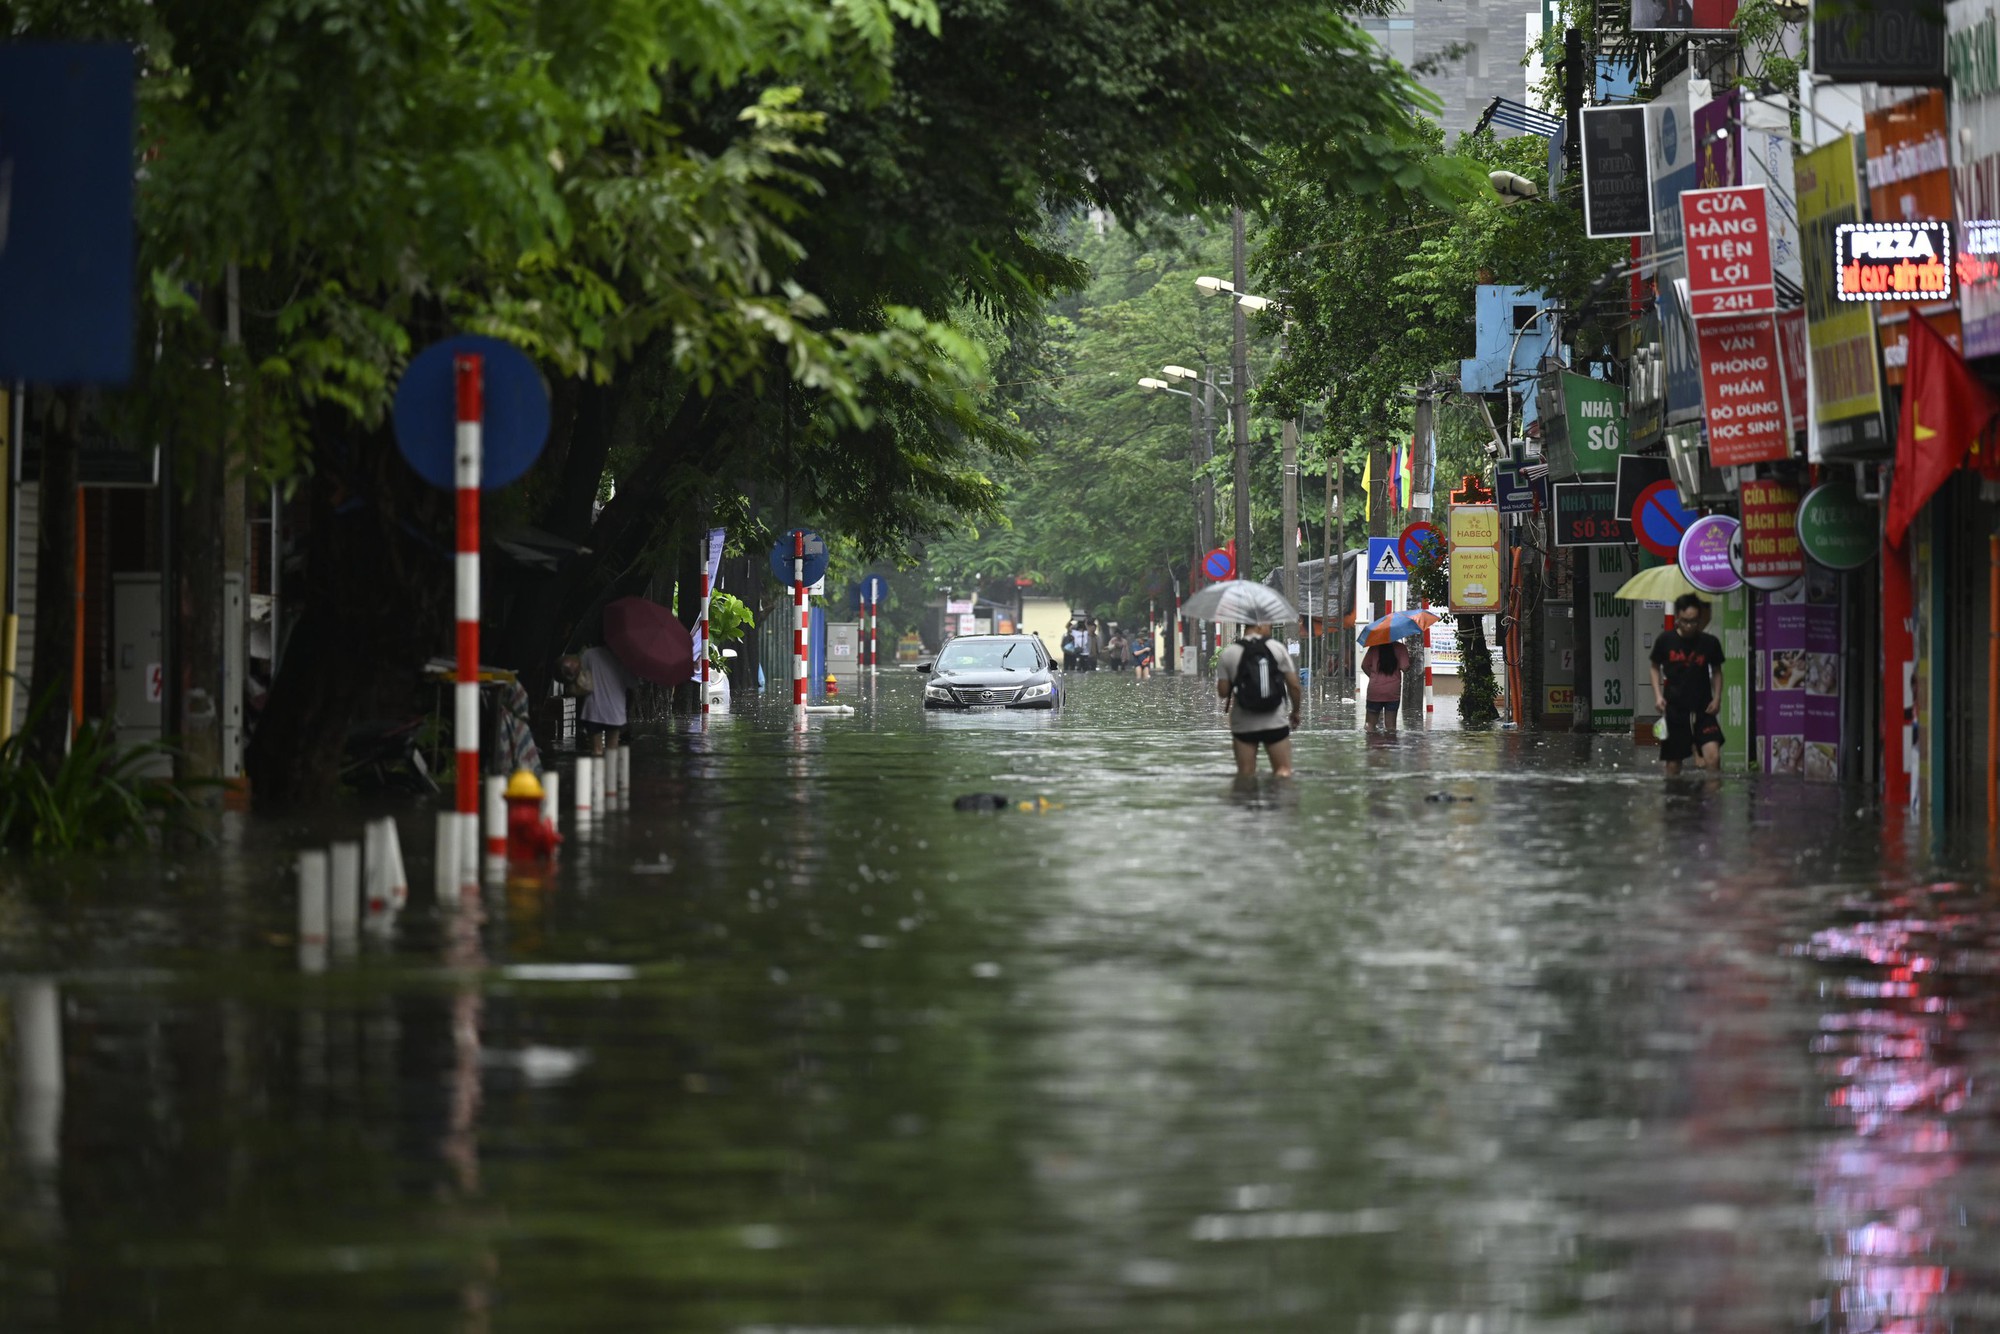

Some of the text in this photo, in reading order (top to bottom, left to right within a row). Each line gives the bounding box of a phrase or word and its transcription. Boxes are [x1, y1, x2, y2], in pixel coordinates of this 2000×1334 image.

[1598, 153, 1635, 173] NHÀ
[1592, 173, 1644, 195] THUỐC
[1696, 193, 1747, 214] CỬA
[1689, 217, 1758, 238] HÀNG
[1696, 239, 1753, 262] TIỆN
[1851, 230, 1934, 258] PIZZA
[1710, 262, 1750, 285] LỢI
[1712, 293, 1754, 311] 24H
[1720, 335, 1755, 352] VĂN
[1710, 356, 1768, 376] PHÒNG
[1719, 377, 1765, 398] PHẨM
[1581, 398, 1614, 418] NHÀ
[1711, 400, 1778, 420] ĐỒ DÙNG
[1712, 420, 1780, 440] HỌC SINH
[1590, 493, 1615, 511] THU
[1744, 484, 1766, 505] CỬA
[1571, 513, 1621, 538] SỐ 33
[1746, 511, 1775, 530] BÁCH
[1747, 533, 1776, 555] TỔNG
[1604, 628, 1619, 662] SỐ
[1604, 679, 1621, 705] 33
